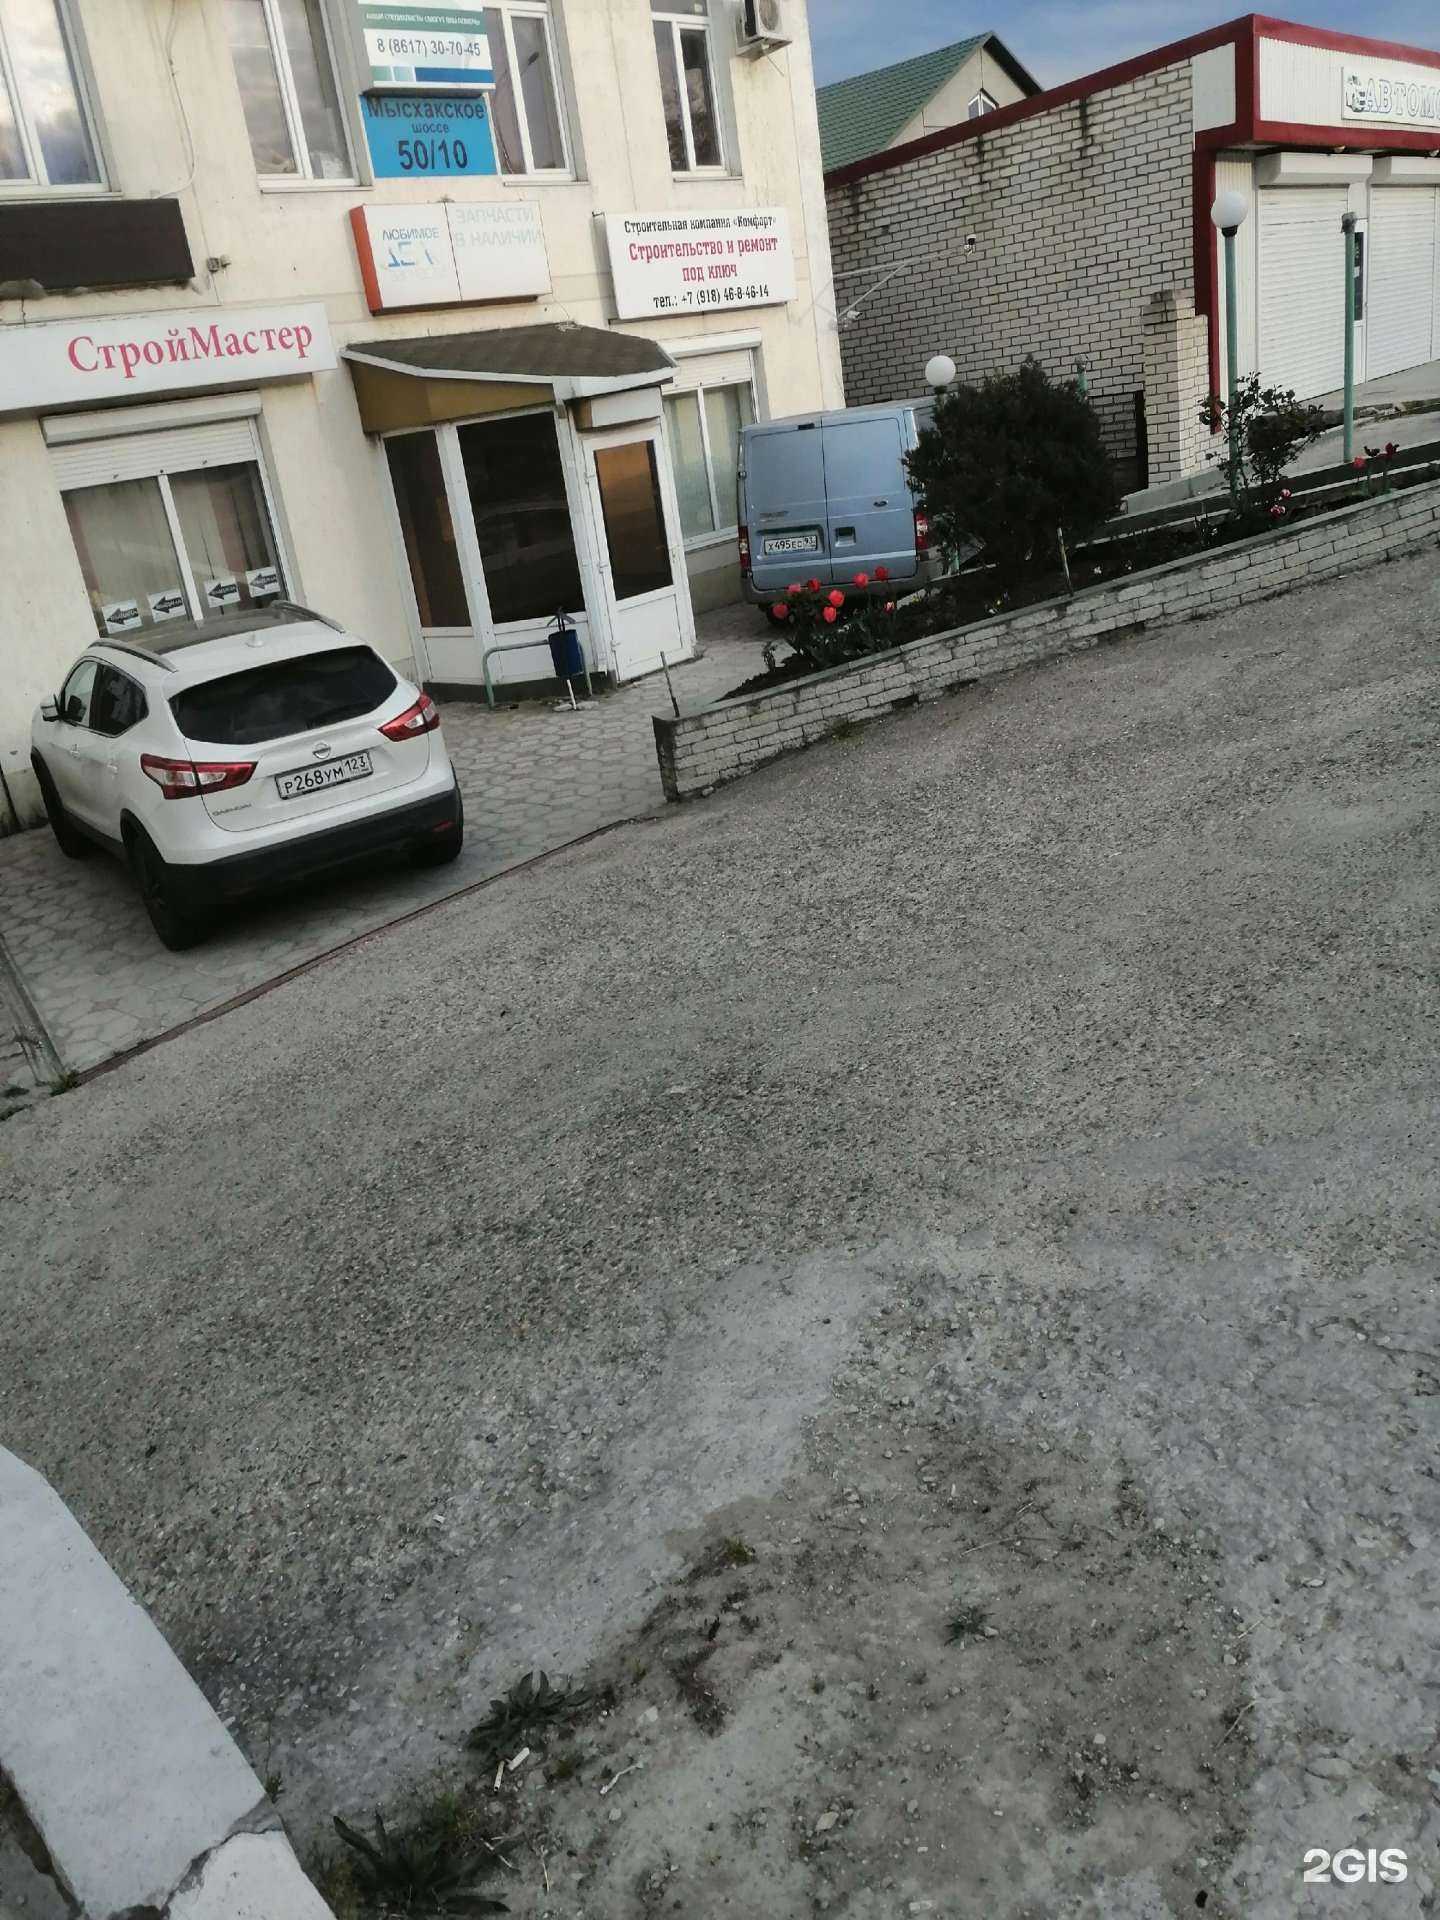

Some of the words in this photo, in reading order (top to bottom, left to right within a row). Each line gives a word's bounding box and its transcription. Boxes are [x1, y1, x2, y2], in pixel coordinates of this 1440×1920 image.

[377, 38, 386, 53] 8
[389, 39, 428, 57] (8617)
[431, 41, 481, 56] 30-70-45
[367, 99, 486, 119] Мысхакское
[411, 122, 450, 134] шоссе
[398, 138, 468, 170] 50/10
[455, 207, 534, 224] ЗАПЧАСТИ
[624, 219, 688, 236] Строительная
[629, 242, 724, 263] Строительство
[727, 240, 734, 253] и
[738, 237, 778, 257] ремонт
[682, 267, 705, 282] под
[708, 264, 738, 279] ключ
[653, 295, 678, 309] тел.:
[681, 291, 693, 305] +7
[696, 288, 720, 305] (918)
[723, 284, 769, 301] 46-8-46-14
[68, 324, 312, 378] СтройМастер
